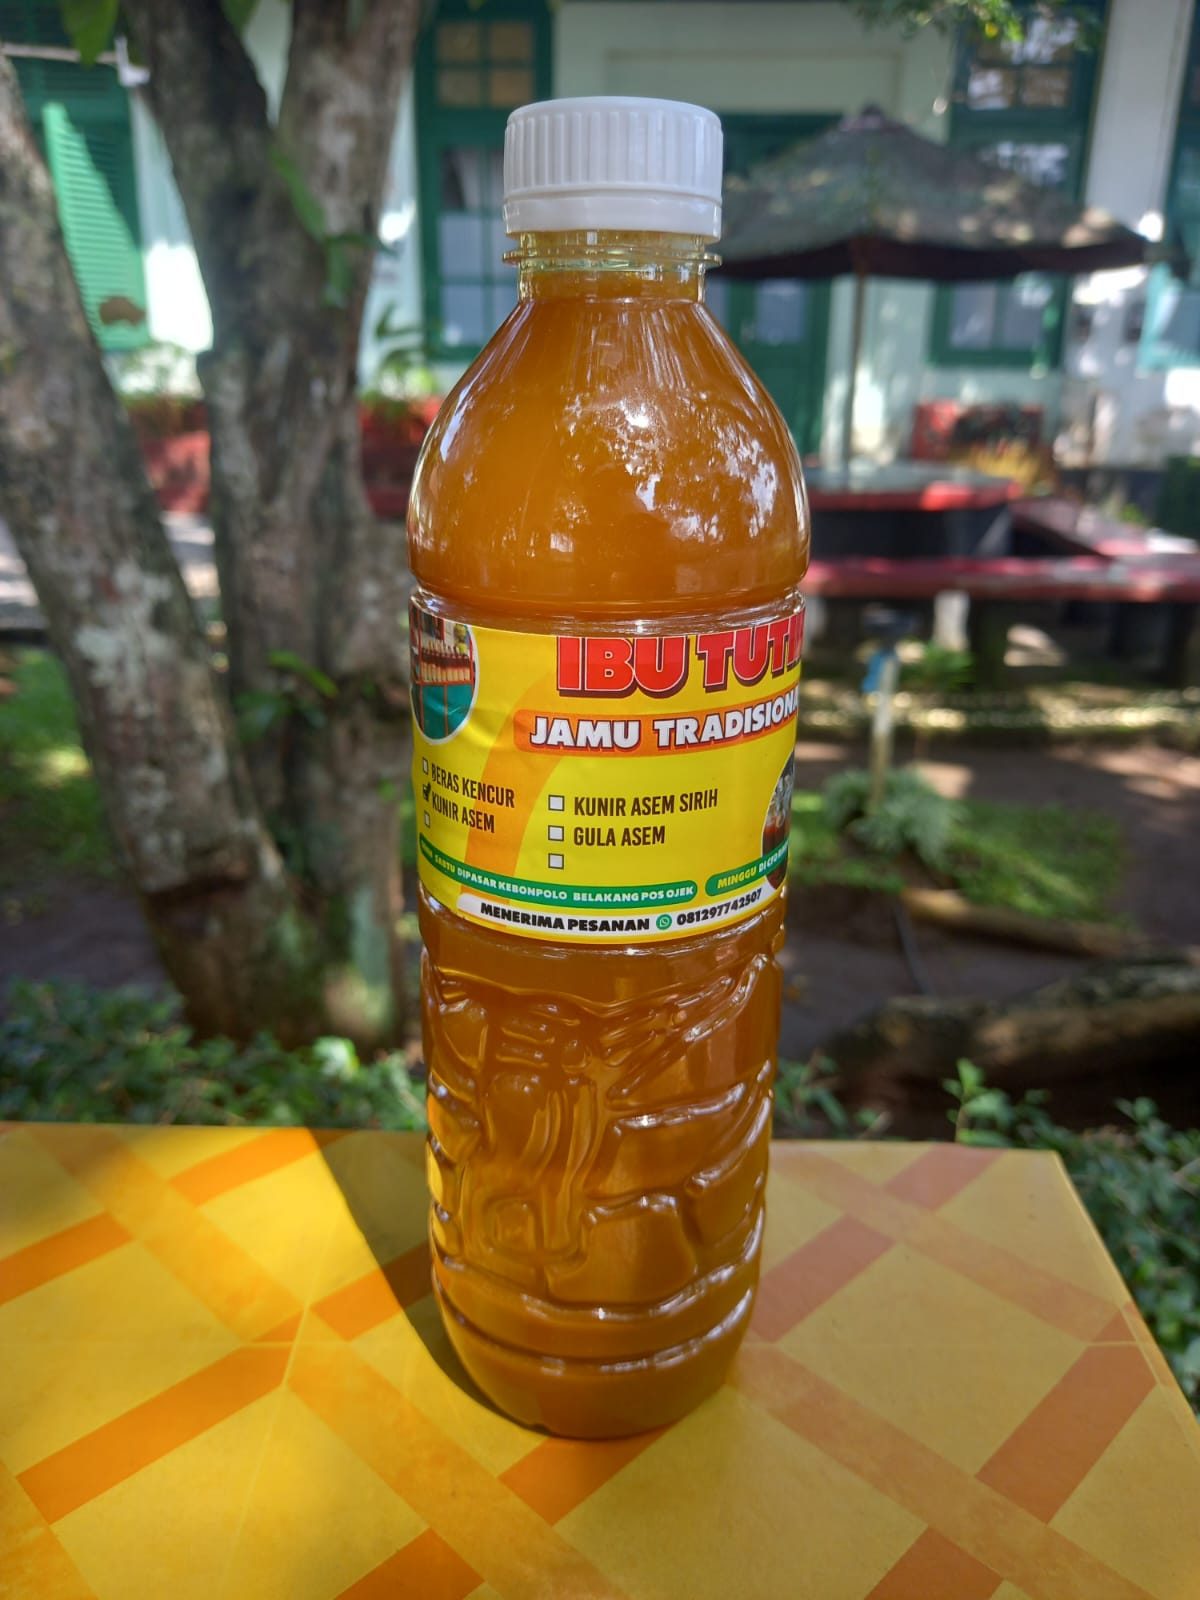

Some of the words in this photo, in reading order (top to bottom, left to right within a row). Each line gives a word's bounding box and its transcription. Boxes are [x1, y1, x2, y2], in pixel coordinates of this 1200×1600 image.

[557, 635, 689, 699] IBU
[530, 716, 641, 750] JAMU
[431, 763, 459, 793] BERAS
[462, 777, 515, 809] KENCUR
[574, 796, 627, 817] KUNIR
[630, 795, 675, 817] ASEM
[679, 788, 718, 812] SIRIH
[432, 791, 459, 823] KUNIR
[461, 806, 495, 834] ASEM
[573, 826, 616, 847] GULA
[621, 825, 666, 847] ASEM
[457, 867, 497, 888] DIPASAR
[498, 881, 568, 900] KEBONPOLO
[573, 892, 640, 902] BELAKANG
[641, 891, 665, 901] POS
[666, 886, 694, 899] OJEK
[717, 865, 757, 889] MINGGU
[480, 902, 565, 930] MENERIMA
[567, 918, 650, 932] PESANAN
[676, 887, 763, 926] 081297742507
